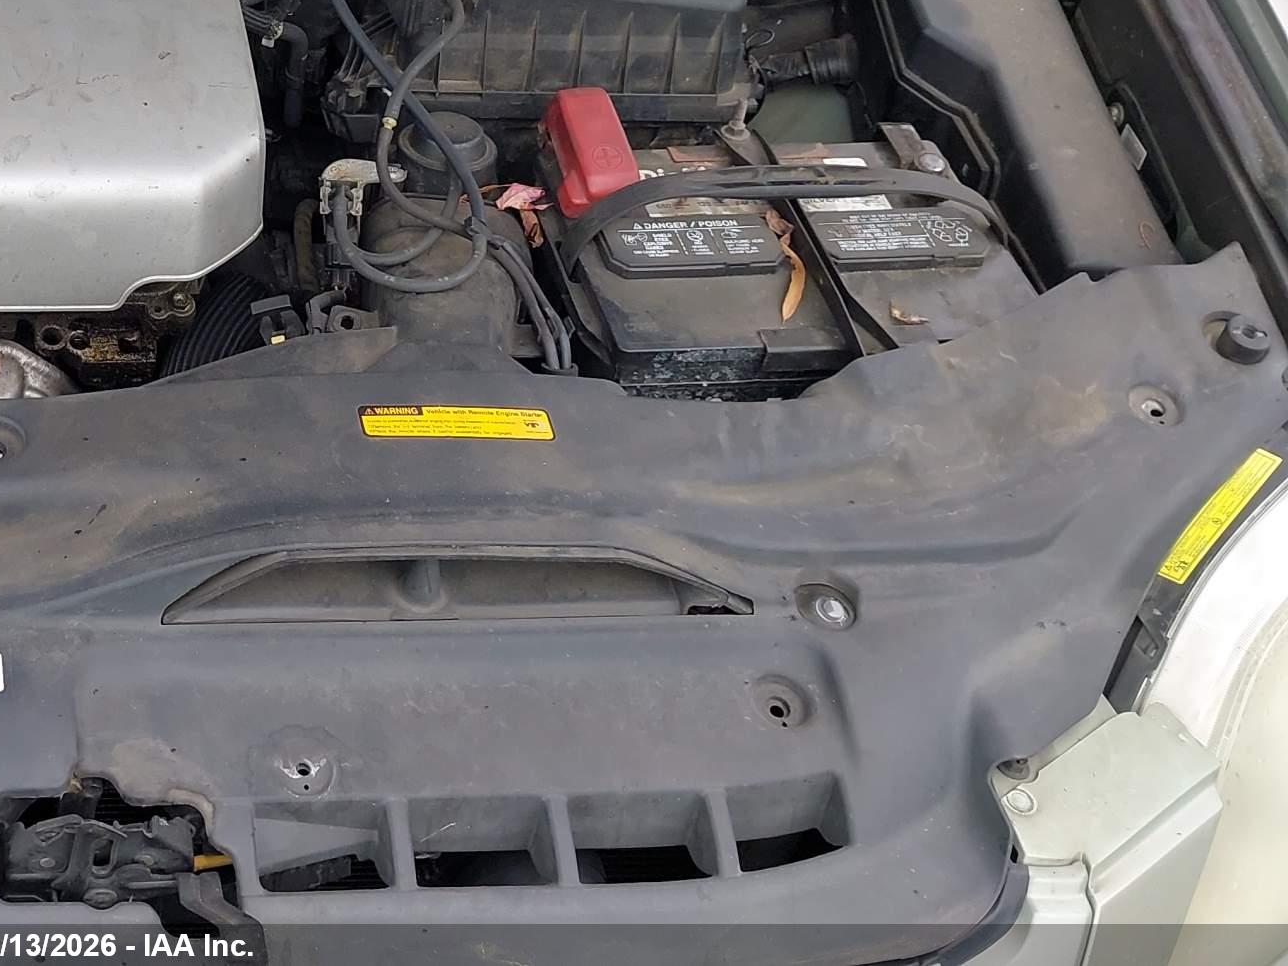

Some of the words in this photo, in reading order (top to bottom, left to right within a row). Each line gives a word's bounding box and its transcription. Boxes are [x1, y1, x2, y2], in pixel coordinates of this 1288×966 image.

[644, 221, 688, 231] DANGER
[698, 219, 739, 228] POISON
[375, 407, 419, 415] WARNING
